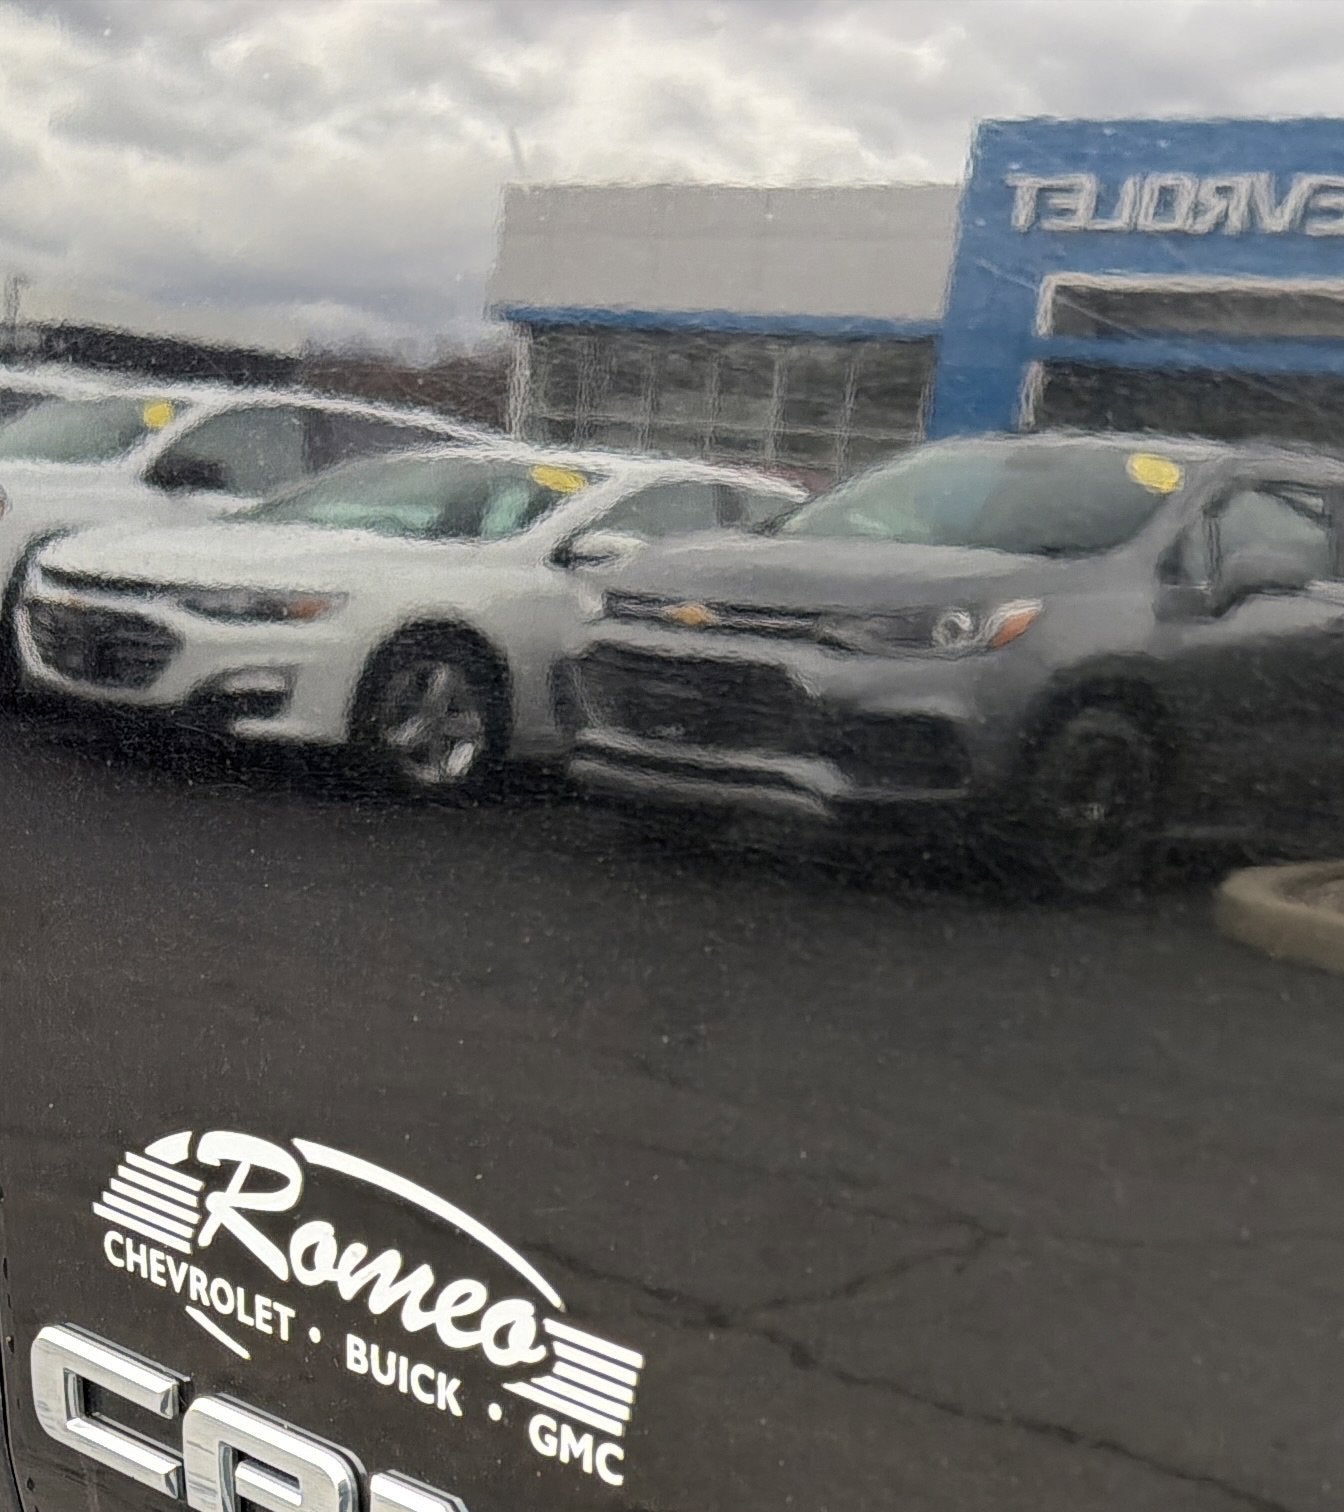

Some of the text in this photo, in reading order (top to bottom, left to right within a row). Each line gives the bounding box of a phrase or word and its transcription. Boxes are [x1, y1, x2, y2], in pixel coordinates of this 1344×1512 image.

[103, 1230, 625, 1487] CHEVROLET BUICK GMC
[196, 1130, 548, 1367] Romeo
